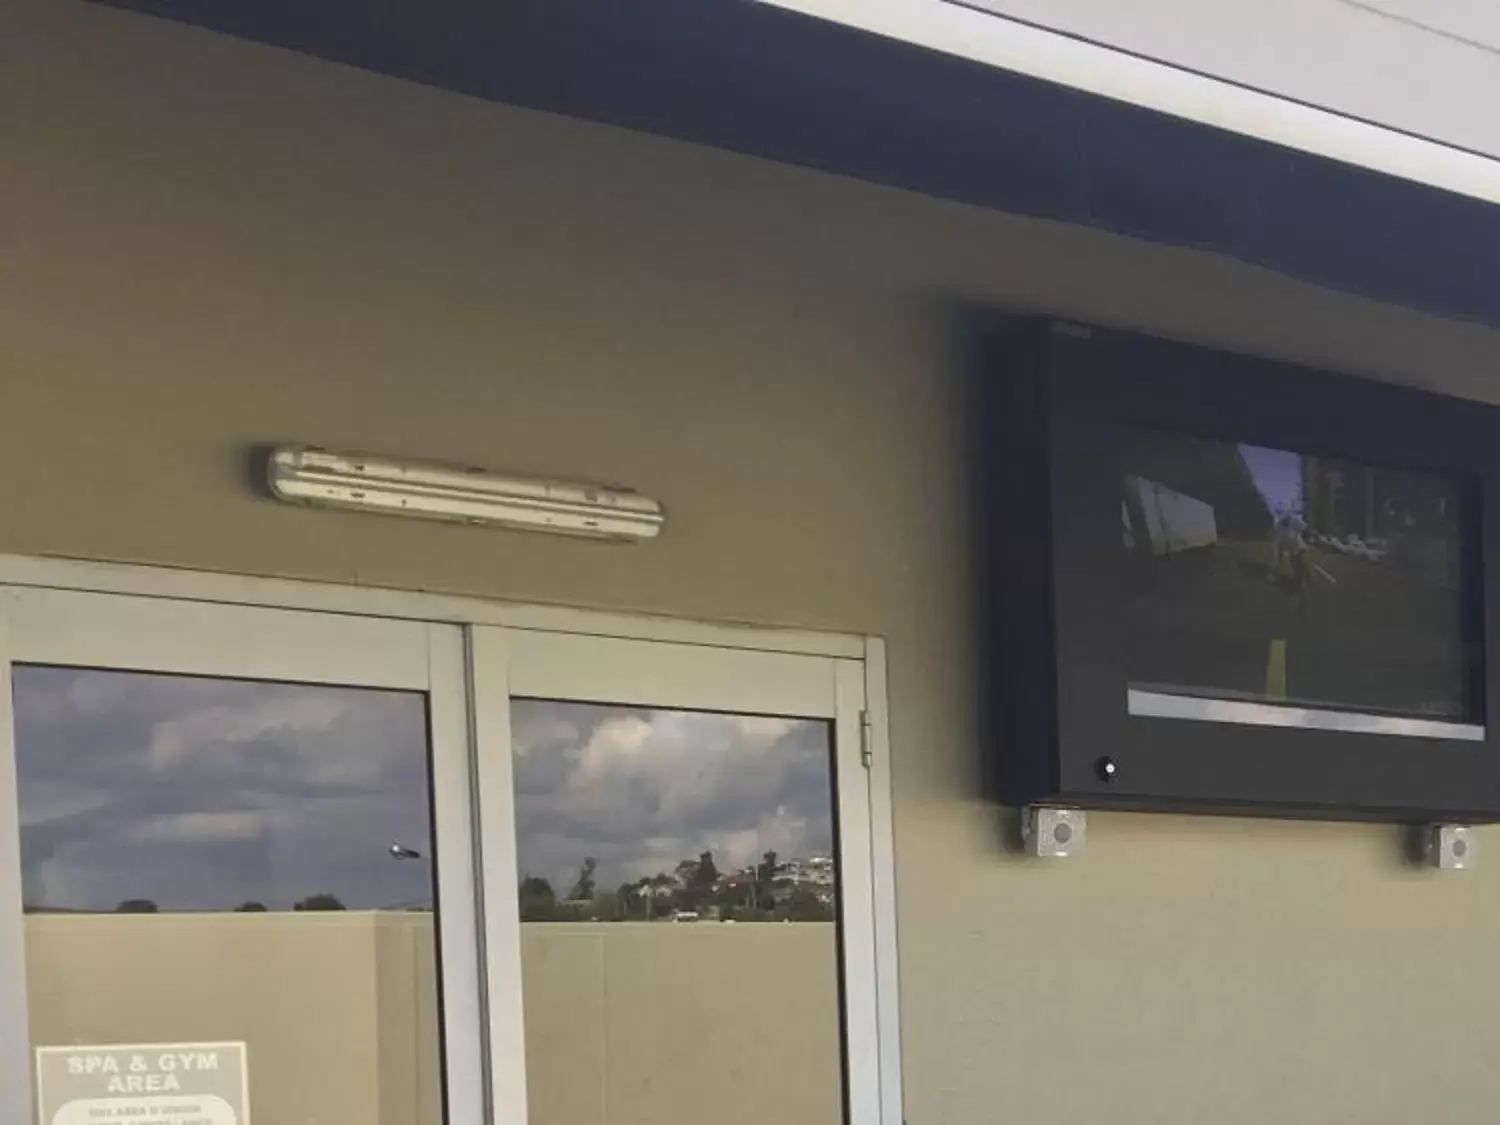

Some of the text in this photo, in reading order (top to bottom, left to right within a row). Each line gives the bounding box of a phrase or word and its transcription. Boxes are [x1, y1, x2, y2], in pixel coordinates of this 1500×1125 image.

[66, 1052, 219, 1075] SPA & GYM
[107, 1074, 181, 1094] AREA
